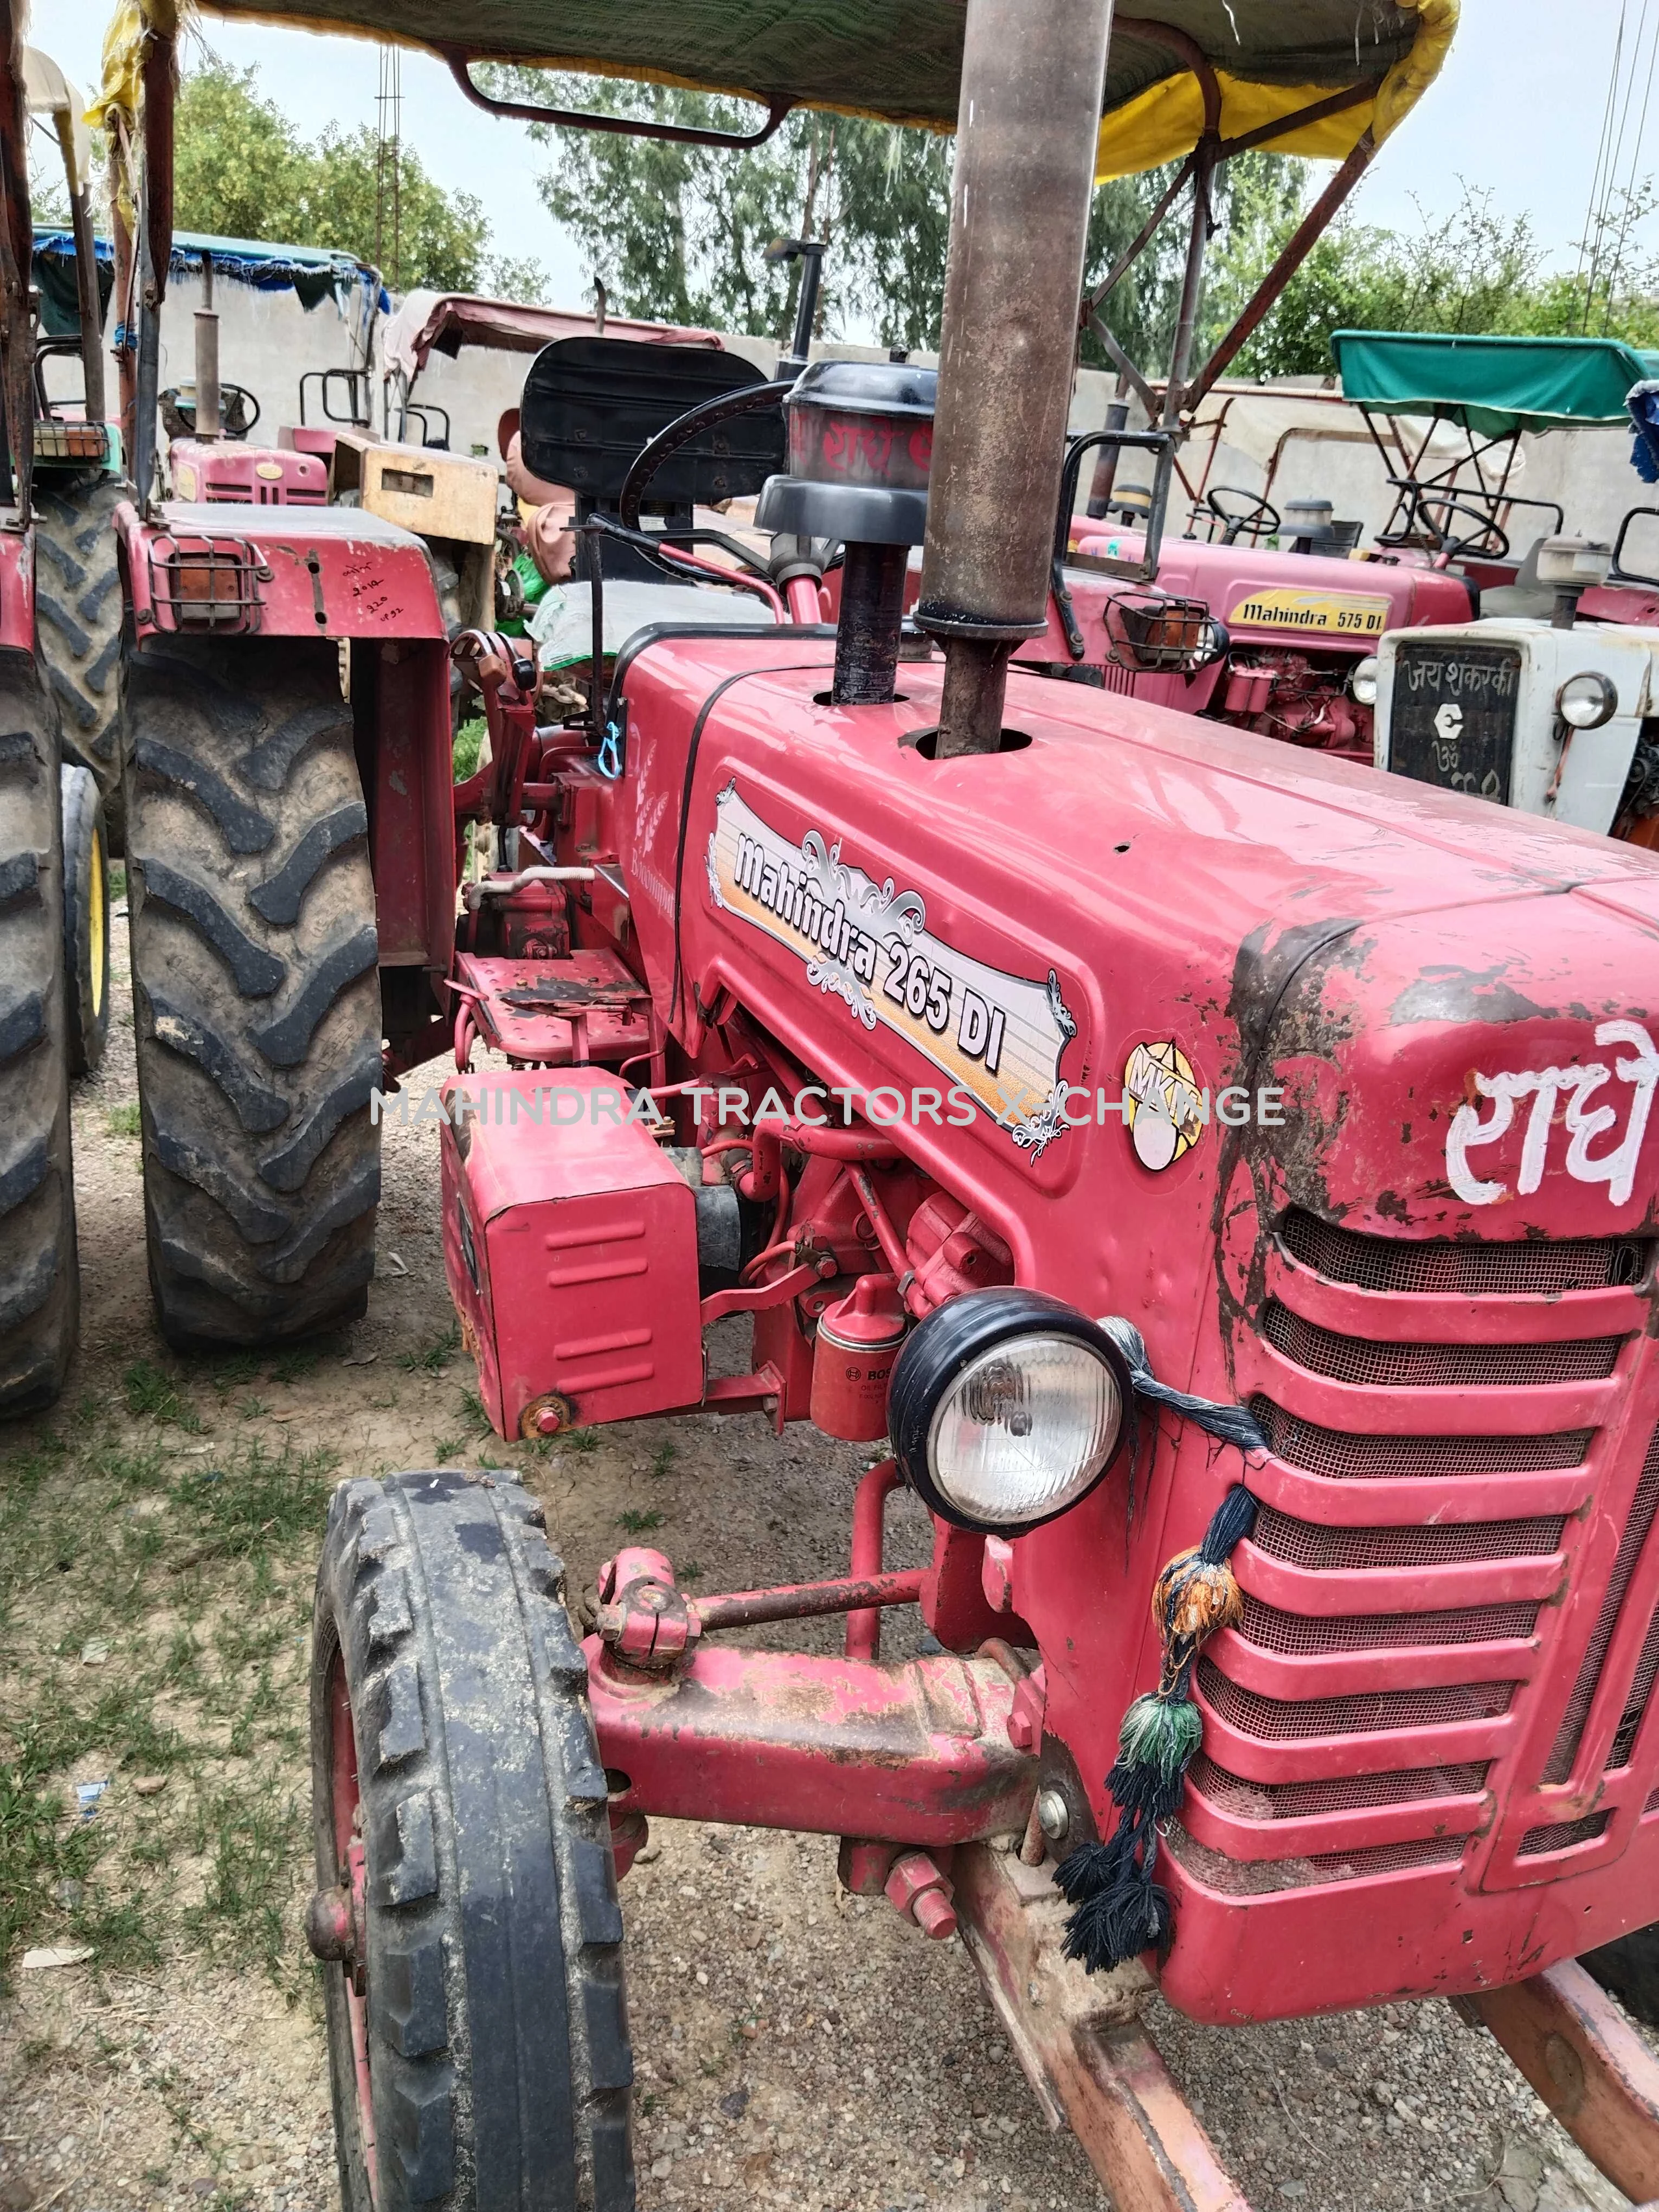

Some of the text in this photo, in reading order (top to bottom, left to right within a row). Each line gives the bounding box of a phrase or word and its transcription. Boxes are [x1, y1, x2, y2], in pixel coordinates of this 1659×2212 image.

[1243, 603, 1381, 631] Mahindra 575 DI
[1402, 660, 1445, 692] जय
[734, 833, 1005, 1072] Mahindra 265 DI
[1445, 1019, 1659, 1206] राधे
